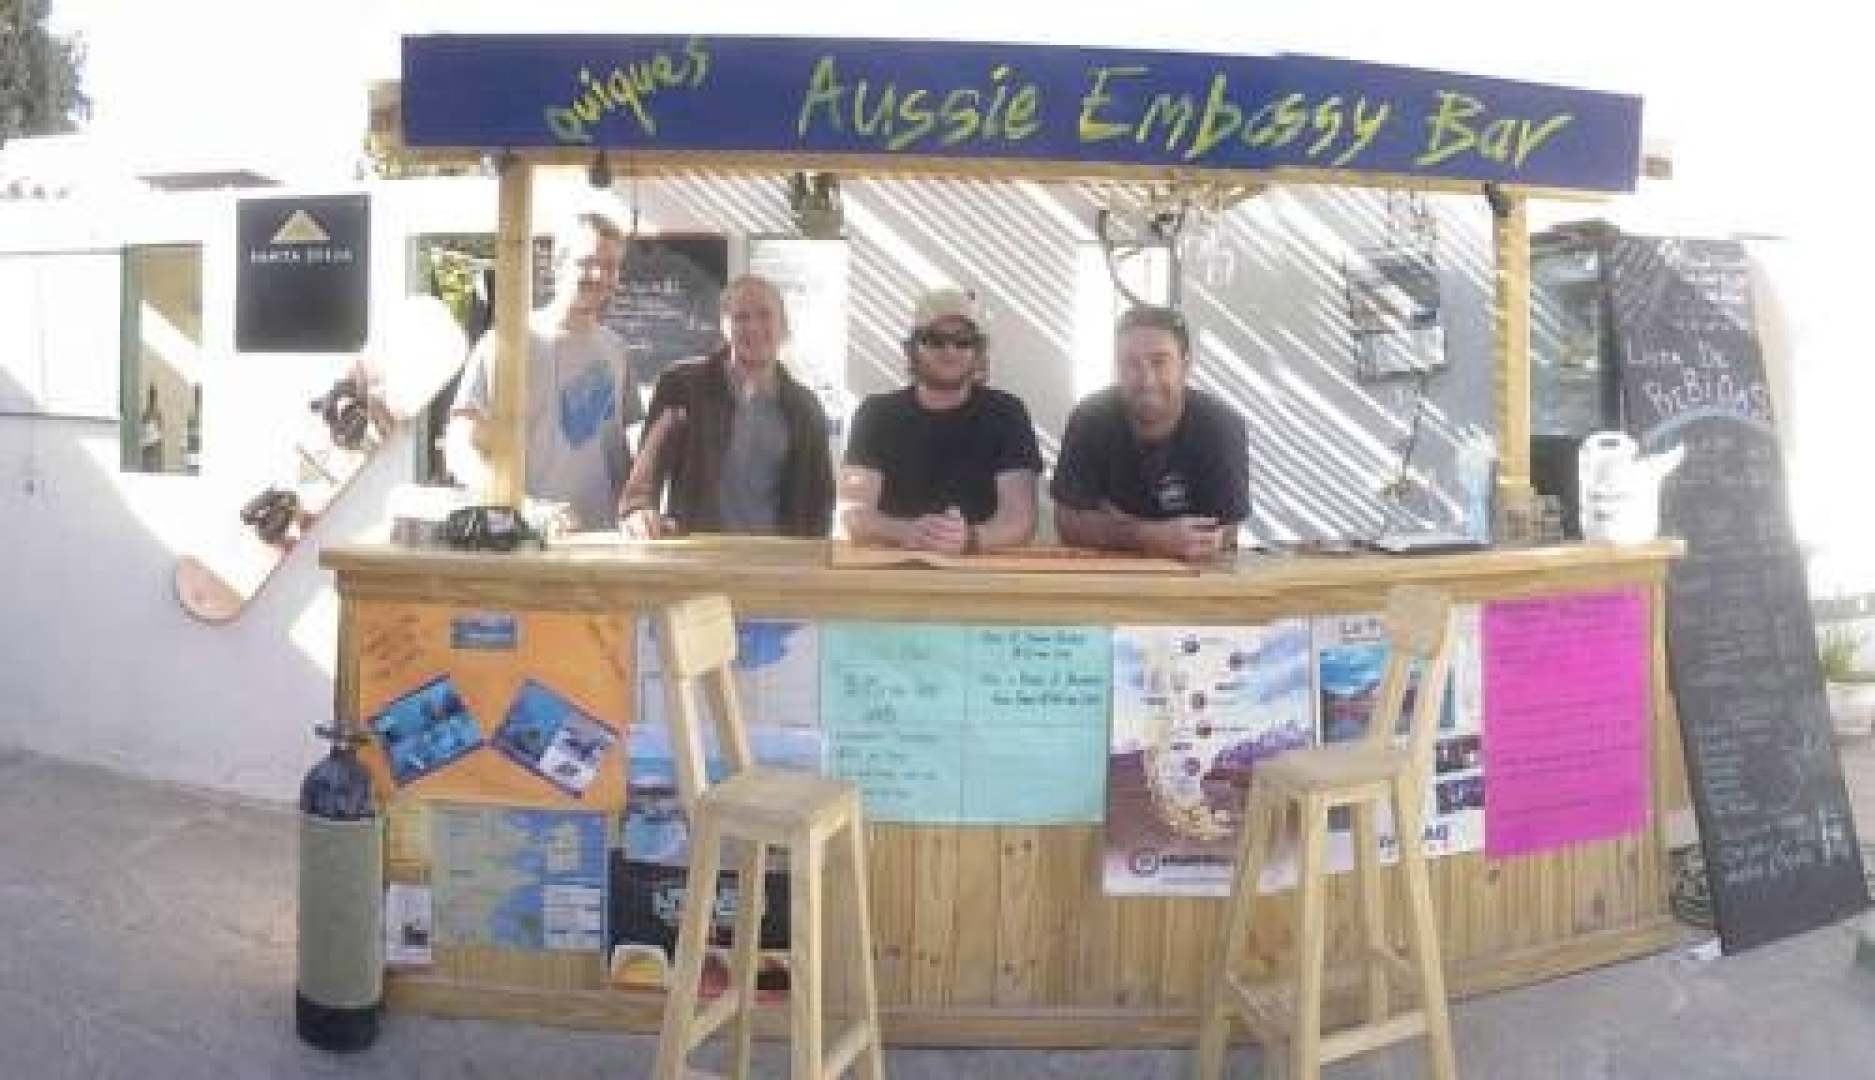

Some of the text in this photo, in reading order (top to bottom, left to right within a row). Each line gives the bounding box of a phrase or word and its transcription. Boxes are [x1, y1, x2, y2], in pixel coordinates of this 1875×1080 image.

[798, 54, 1574, 169] Aussie Embassy Bar
